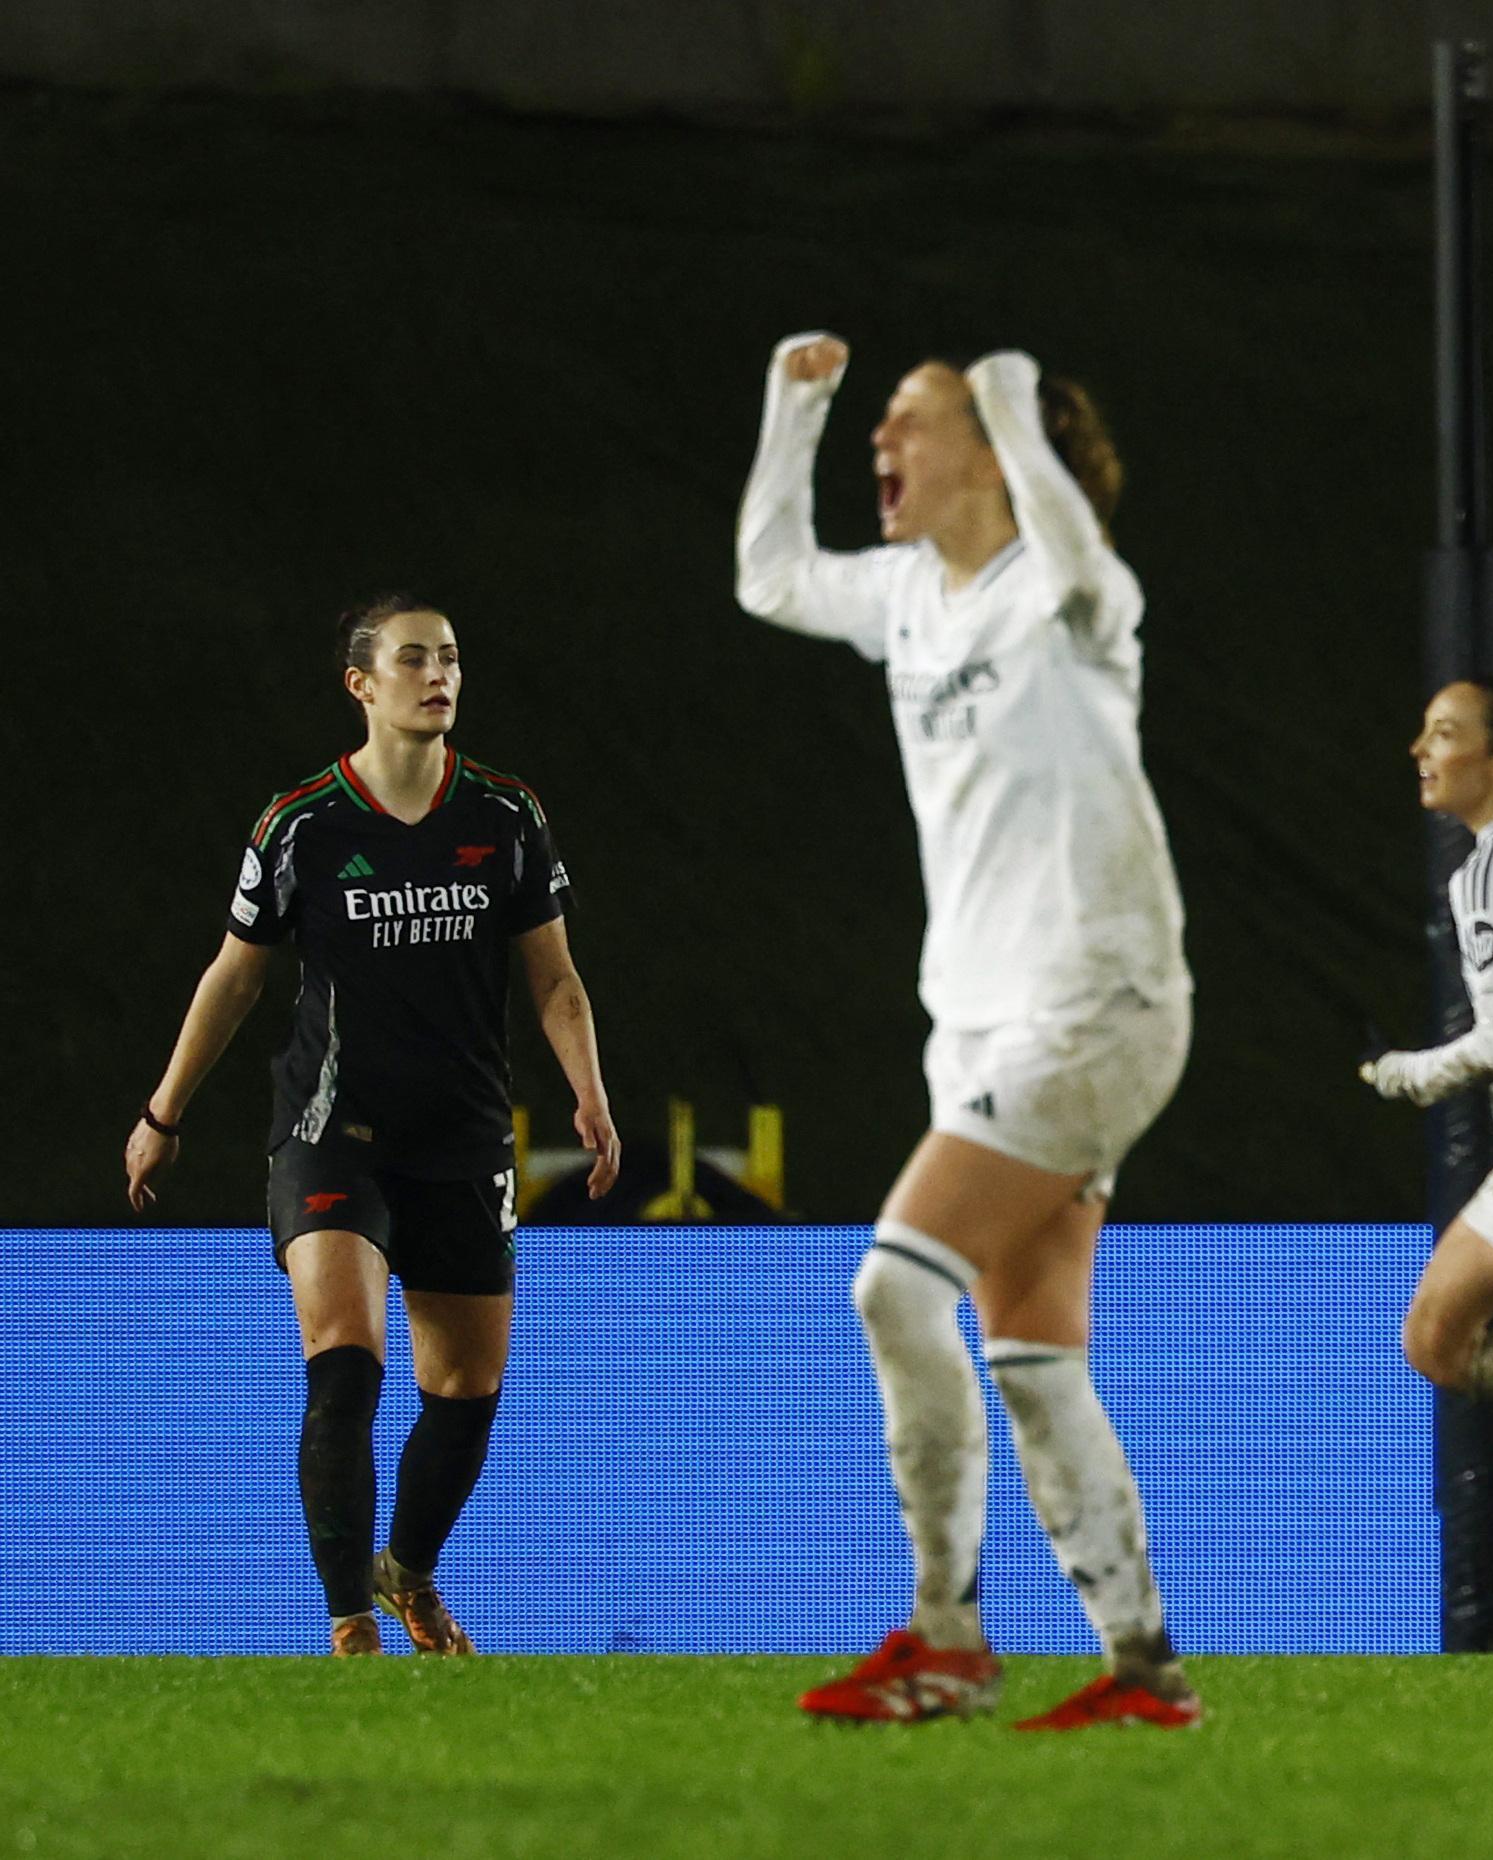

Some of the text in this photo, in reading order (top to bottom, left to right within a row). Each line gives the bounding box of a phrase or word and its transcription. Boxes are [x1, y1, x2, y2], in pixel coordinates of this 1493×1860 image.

[344, 882, 490, 920] Emirates
[373, 915, 475, 948] FLY BETTER
